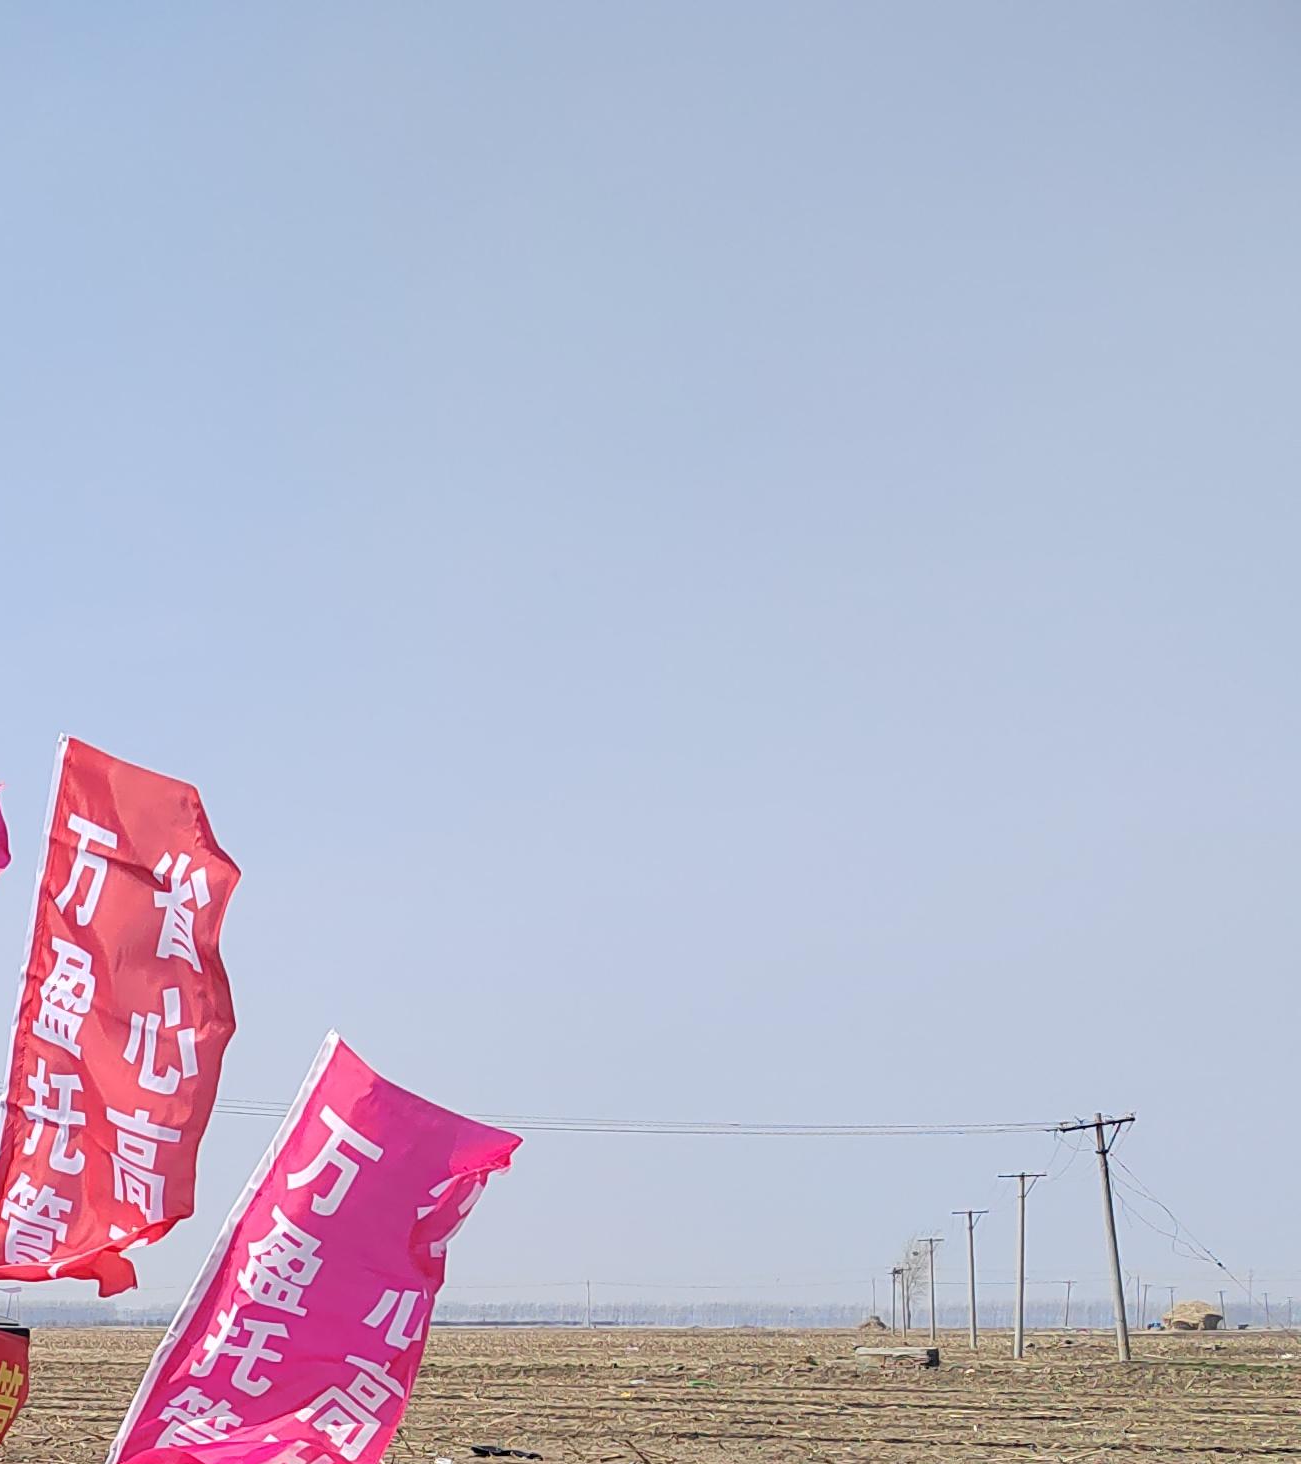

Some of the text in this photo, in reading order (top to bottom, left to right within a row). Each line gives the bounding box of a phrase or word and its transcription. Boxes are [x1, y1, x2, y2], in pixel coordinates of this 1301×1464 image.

[1, 813, 117, 1264] 万盈托管
[106, 850, 213, 1248] 省心高
